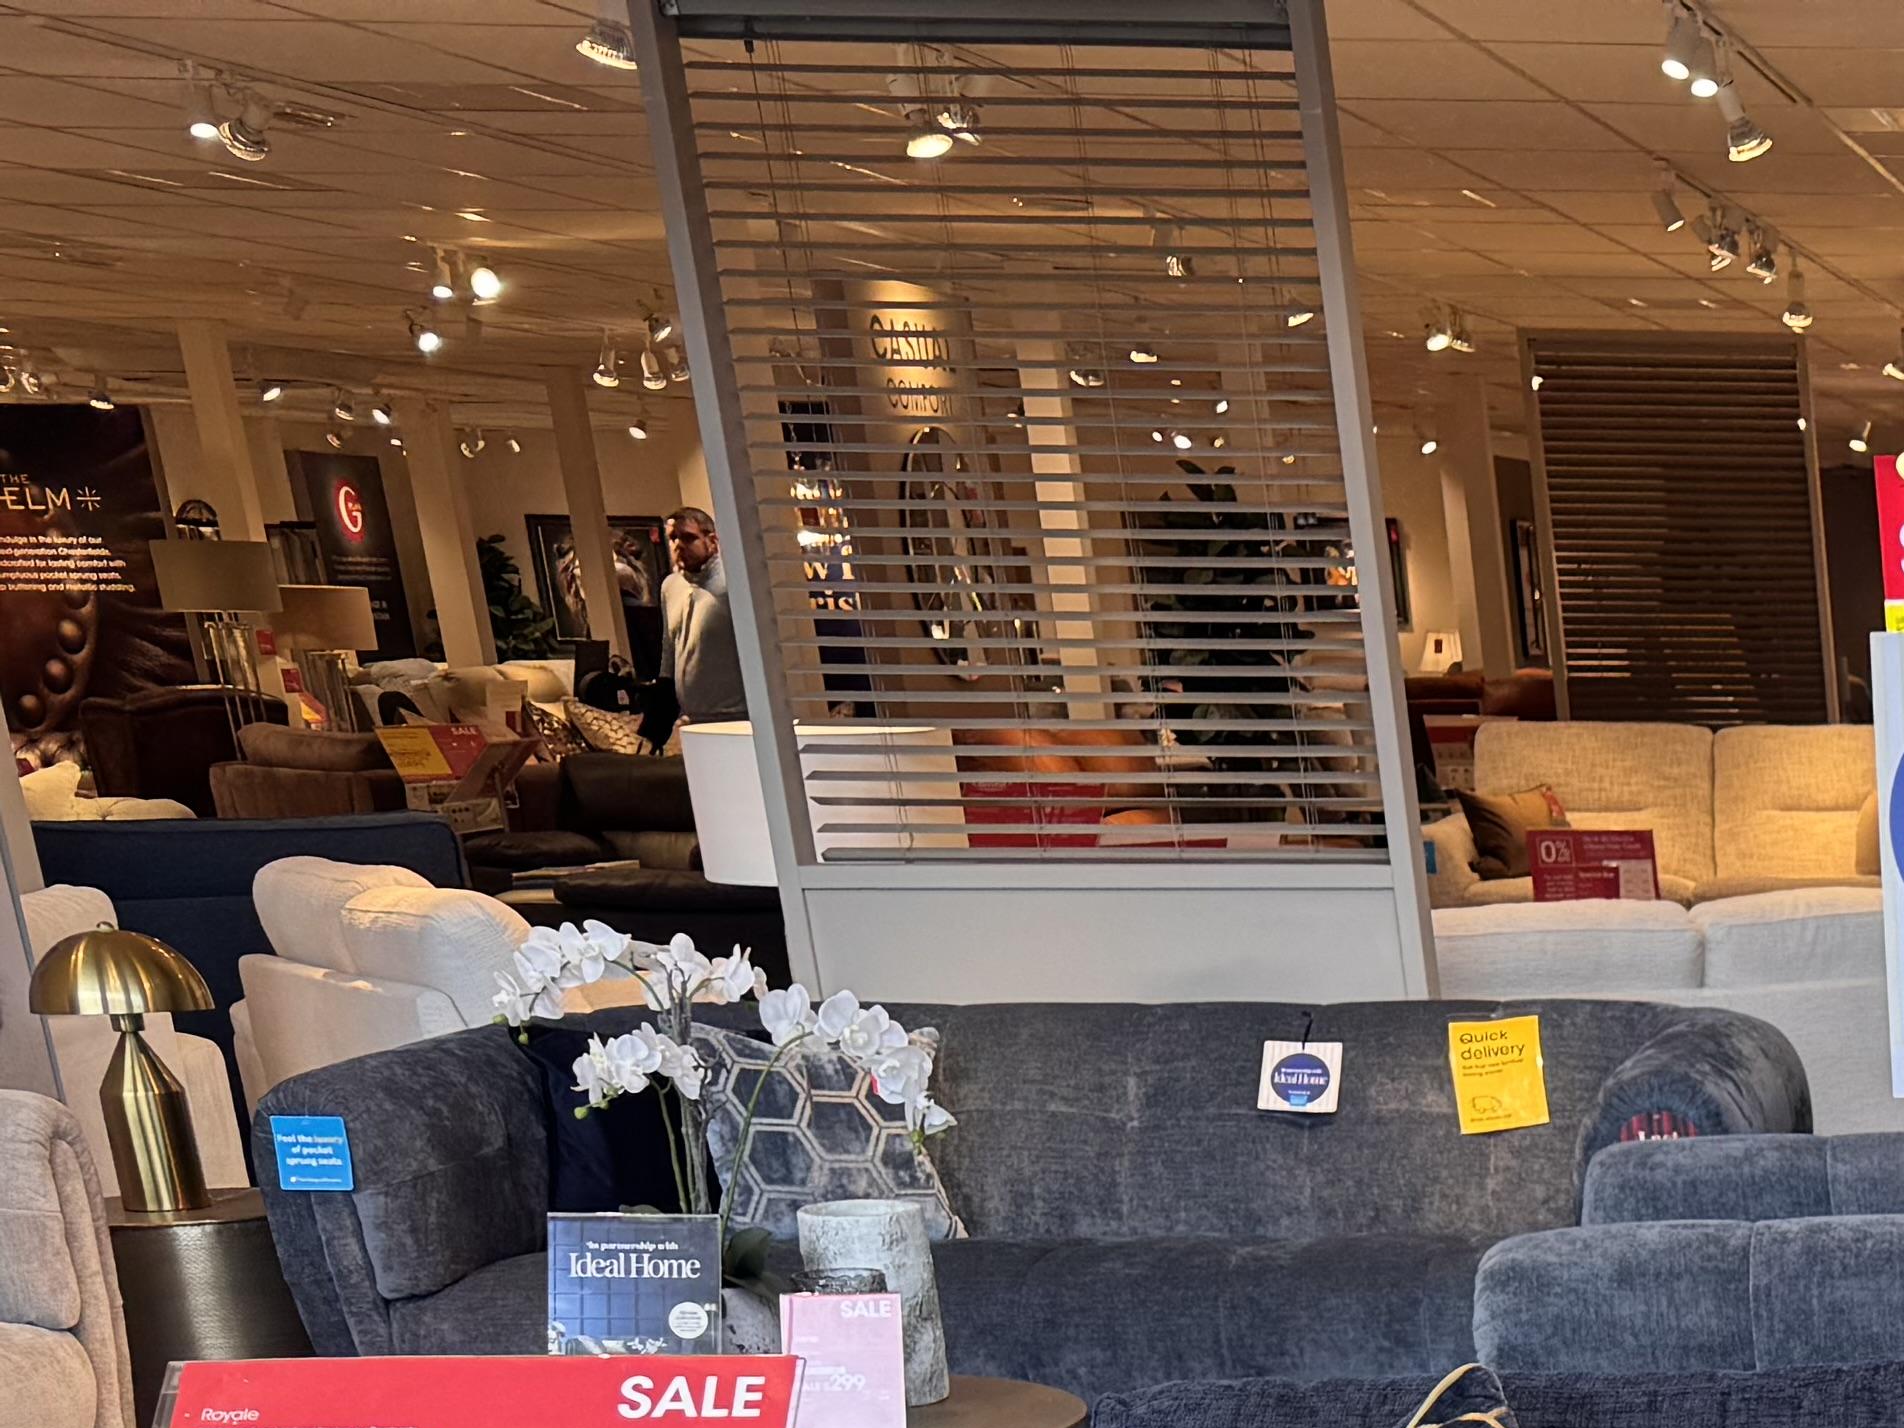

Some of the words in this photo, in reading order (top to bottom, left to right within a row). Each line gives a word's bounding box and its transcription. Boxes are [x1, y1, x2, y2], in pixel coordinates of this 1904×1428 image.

[1459, 1030, 1508, 1044] Quick
[1460, 1044, 1525, 1061] delivery
[568, 1252, 626, 1278] Ideal
[629, 1253, 701, 1279] Home
[840, 1300, 892, 1318] SALE
[617, 1375, 766, 1419] SALE
[200, 1407, 260, 1424] Royale
